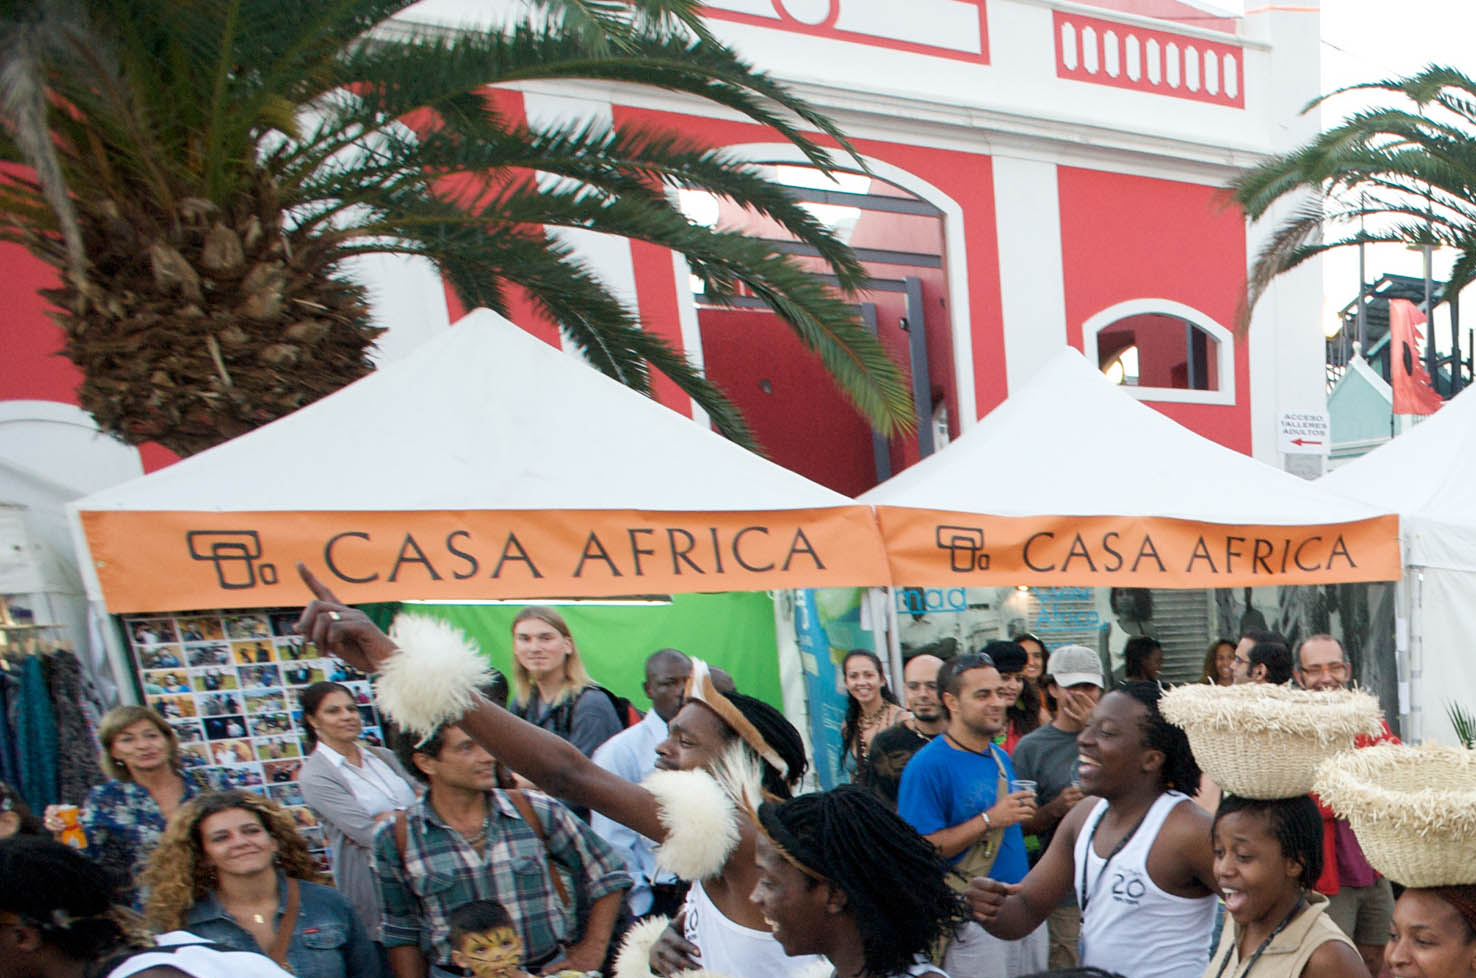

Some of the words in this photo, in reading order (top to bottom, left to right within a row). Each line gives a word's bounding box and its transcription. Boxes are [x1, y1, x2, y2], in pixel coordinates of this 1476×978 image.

[1283, 428, 1326, 436] ADULTOS
[323, 530, 544, 583] CASA
[572, 526, 827, 577] AFRICA
[1022, 531, 1167, 573] CASA
[1185, 533, 1358, 574] AFRICA
[1111, 873, 1145, 899] 20
